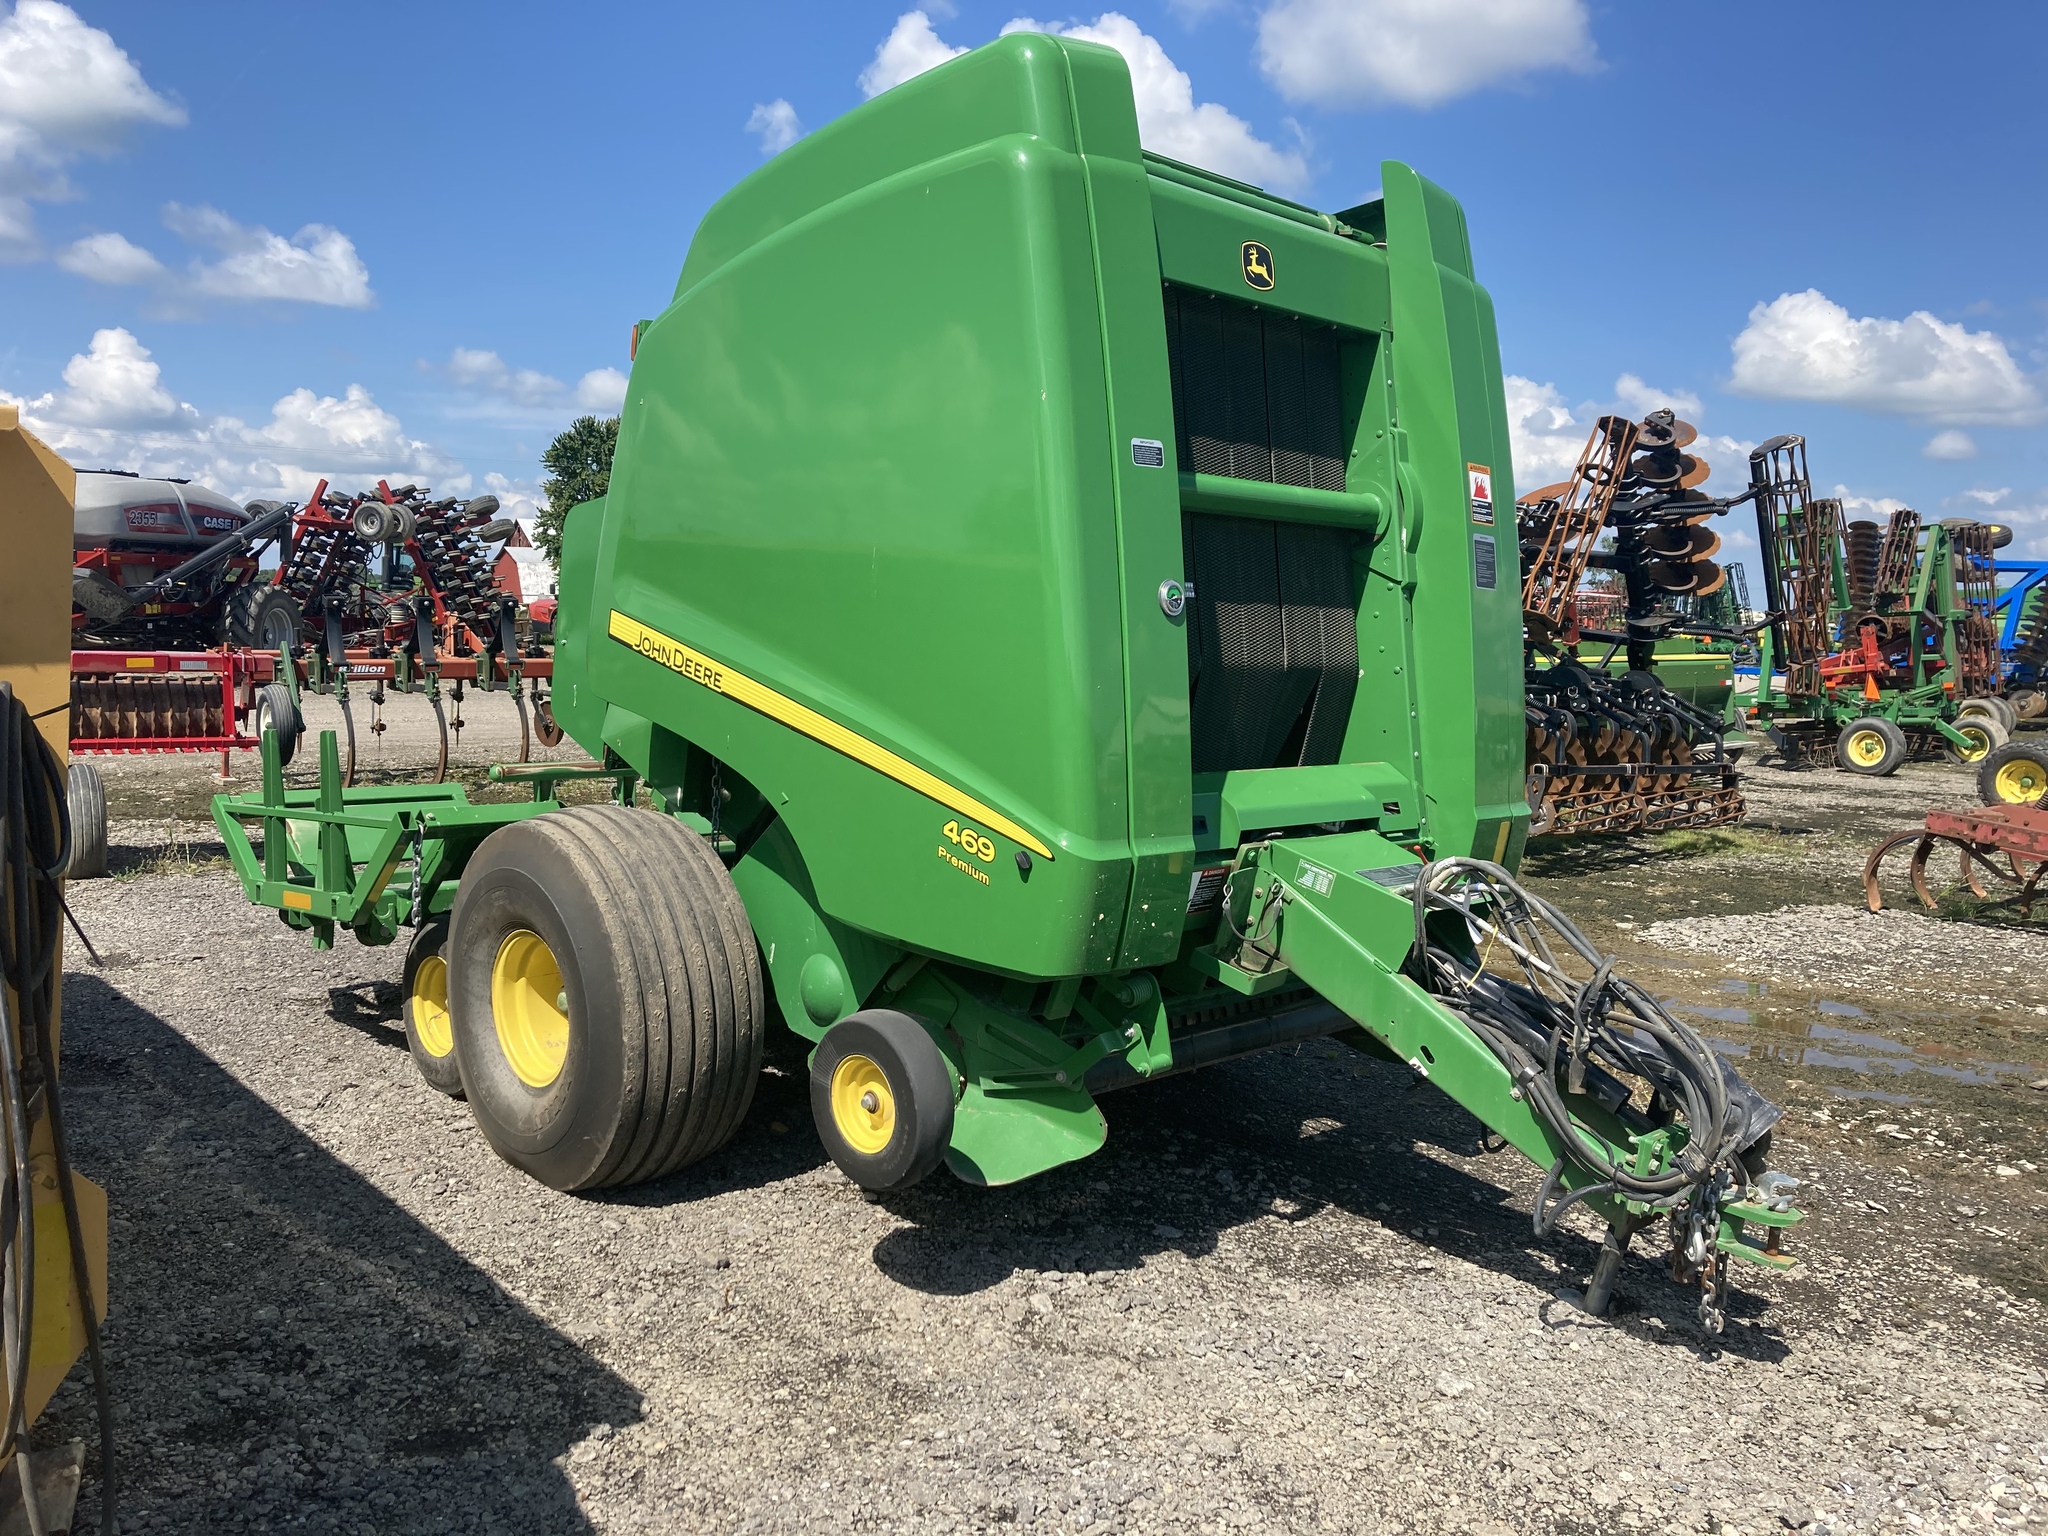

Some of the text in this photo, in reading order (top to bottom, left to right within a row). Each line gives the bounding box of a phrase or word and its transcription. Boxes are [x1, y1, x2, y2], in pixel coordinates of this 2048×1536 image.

[129, 510, 157, 527] 2355
[203, 516, 232, 530] CASE
[634, 631, 723, 690] JOHN DEERE
[942, 819, 996, 863] 469
[937, 845, 990, 887] Premium
